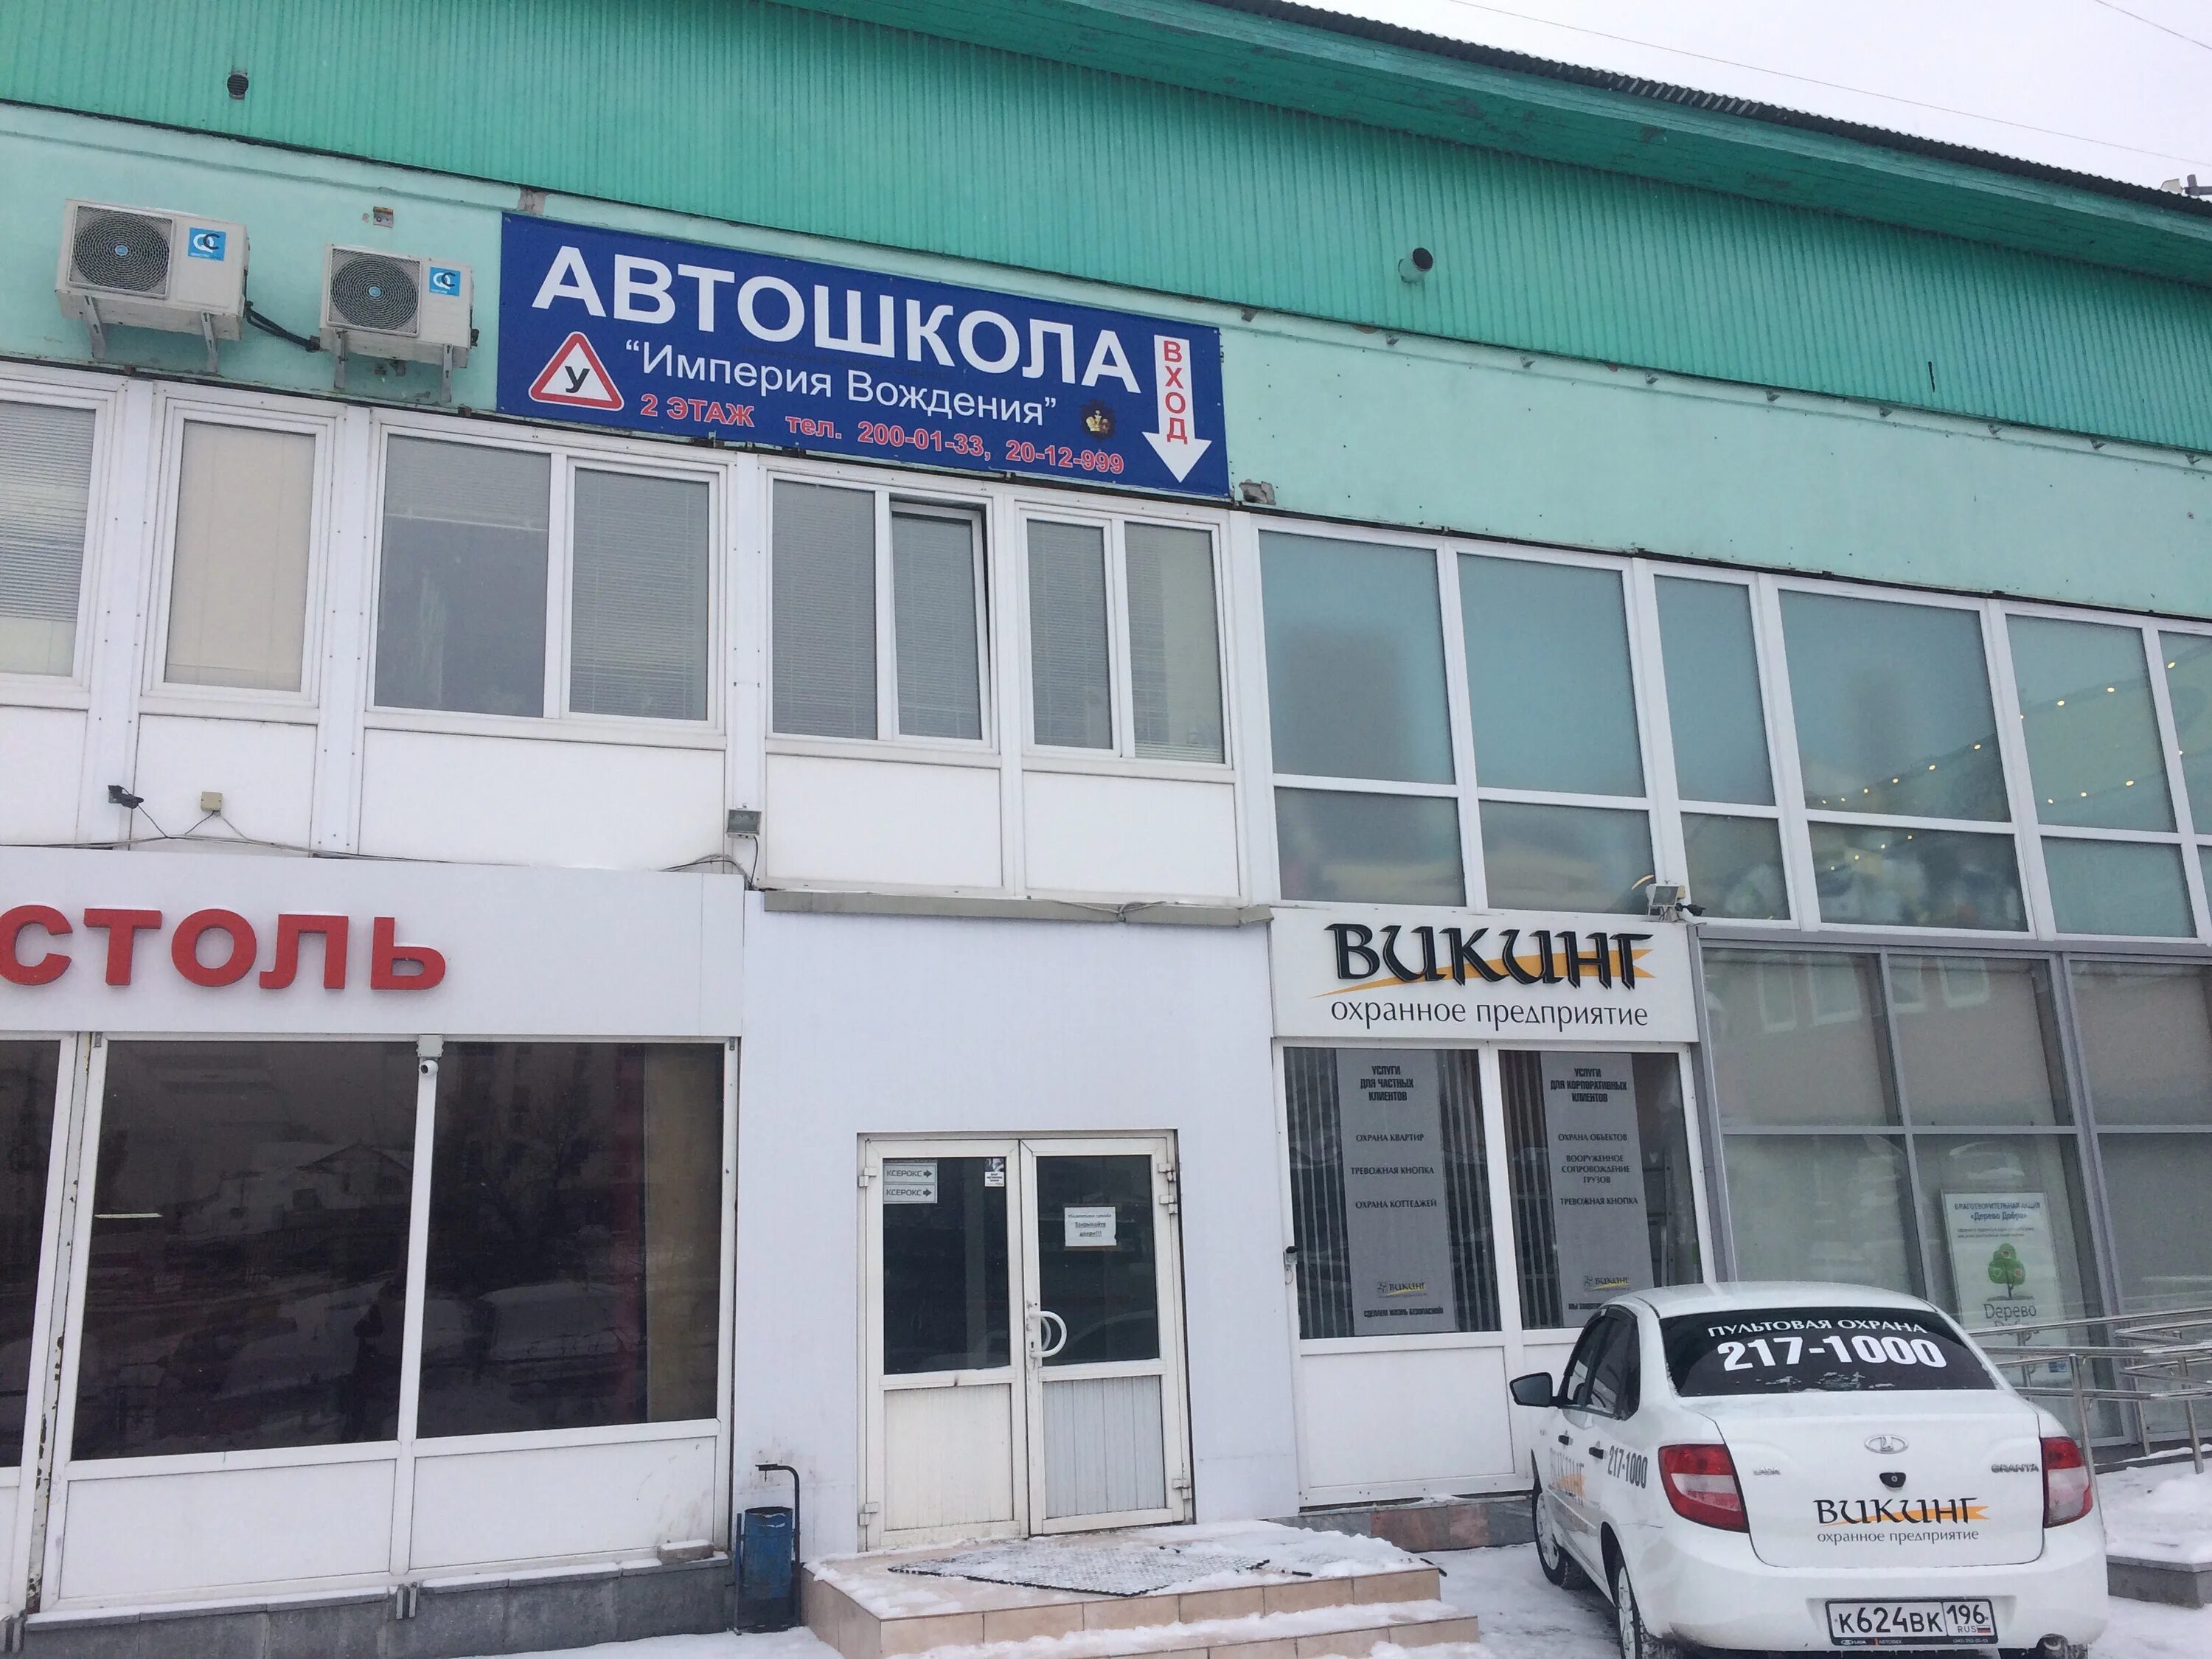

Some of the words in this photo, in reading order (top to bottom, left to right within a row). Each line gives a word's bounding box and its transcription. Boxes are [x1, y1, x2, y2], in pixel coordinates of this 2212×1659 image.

[531, 246, 1142, 394] АВТОШКОЛА
[564, 365, 591, 394] У
[1163, 340, 1189, 445] ВХОД
[639, 392, 658, 417] 2
[666, 396, 755, 428] ЭТАЖ
[785, 414, 842, 440] тел.
[857, 420, 991, 462] 200-01-33,
[1005, 439, 1125, 476] 20-12-999
[0, 905, 447, 991] СТОЛЬ
[1324, 922, 1655, 990] ВИКИНГ
[1330, 1001, 1467, 1029] охранное
[1476, 1004, 1649, 1032] предприятие
[1371, 1065, 1401, 1076] УСЛУГИ
[1573, 1068, 1601, 1077] УСЛУГИ
[1360, 1078, 1377, 1089] ДЛЯ
[1377, 1078, 1414, 1088] ЧАСТНЫХ
[1550, 1080, 1565, 1091] ДЛЯ
[1566, 1080, 1627, 1091] КОРПОРАТИВНЫХ
[1368, 1091, 1408, 1101] КЛИЕНТОВ
[1571, 1093, 1608, 1102] КЛИЕНТОВ
[1356, 1134, 1388, 1142] ОХРАНА
[1390, 1133, 1425, 1141] КВАРТИР
[1558, 1133, 1589, 1141] ОХРАНА
[1590, 1133, 1628, 1141] ОБЪЕКТОВ
[1566, 1155, 1624, 1163] ВООРУЖЕННОЕ
[886, 1169, 922, 1178] КСЕРОКС
[1351, 1166, 1399, 1175] ТРЕВОЖНАЯ
[1400, 1166, 1435, 1175] КНОПКА
[1562, 1165, 1631, 1173] СОПРОВОЖДЕНИЕ
[1355, 1200, 1388, 1209] ОХРАНА
[1389, 1197, 1438, 1208] КОТТЕДЖЕЙ
[1559, 1197, 1605, 1206] ТРЕВОЖНАЯ
[1606, 1197, 1638, 1205] КНОПКА
[1707, 1319, 1833, 1338] ПУЛЬТОВАЯ
[1837, 1320, 1928, 1334] ОХРАНА
[1717, 1335, 1947, 1372] 217-1000
[1607, 1444, 1649, 1489] 217-1000
[1812, 1497, 1978, 1525] ВИКИНГ
[1817, 1530, 1885, 1546] охранное
[1889, 1529, 1980, 1545] предприятие
[1838, 1606, 1944, 1634] К624ВК
[1946, 1604, 1986, 1625] 196
[1957, 1625, 1977, 1633] RUS
